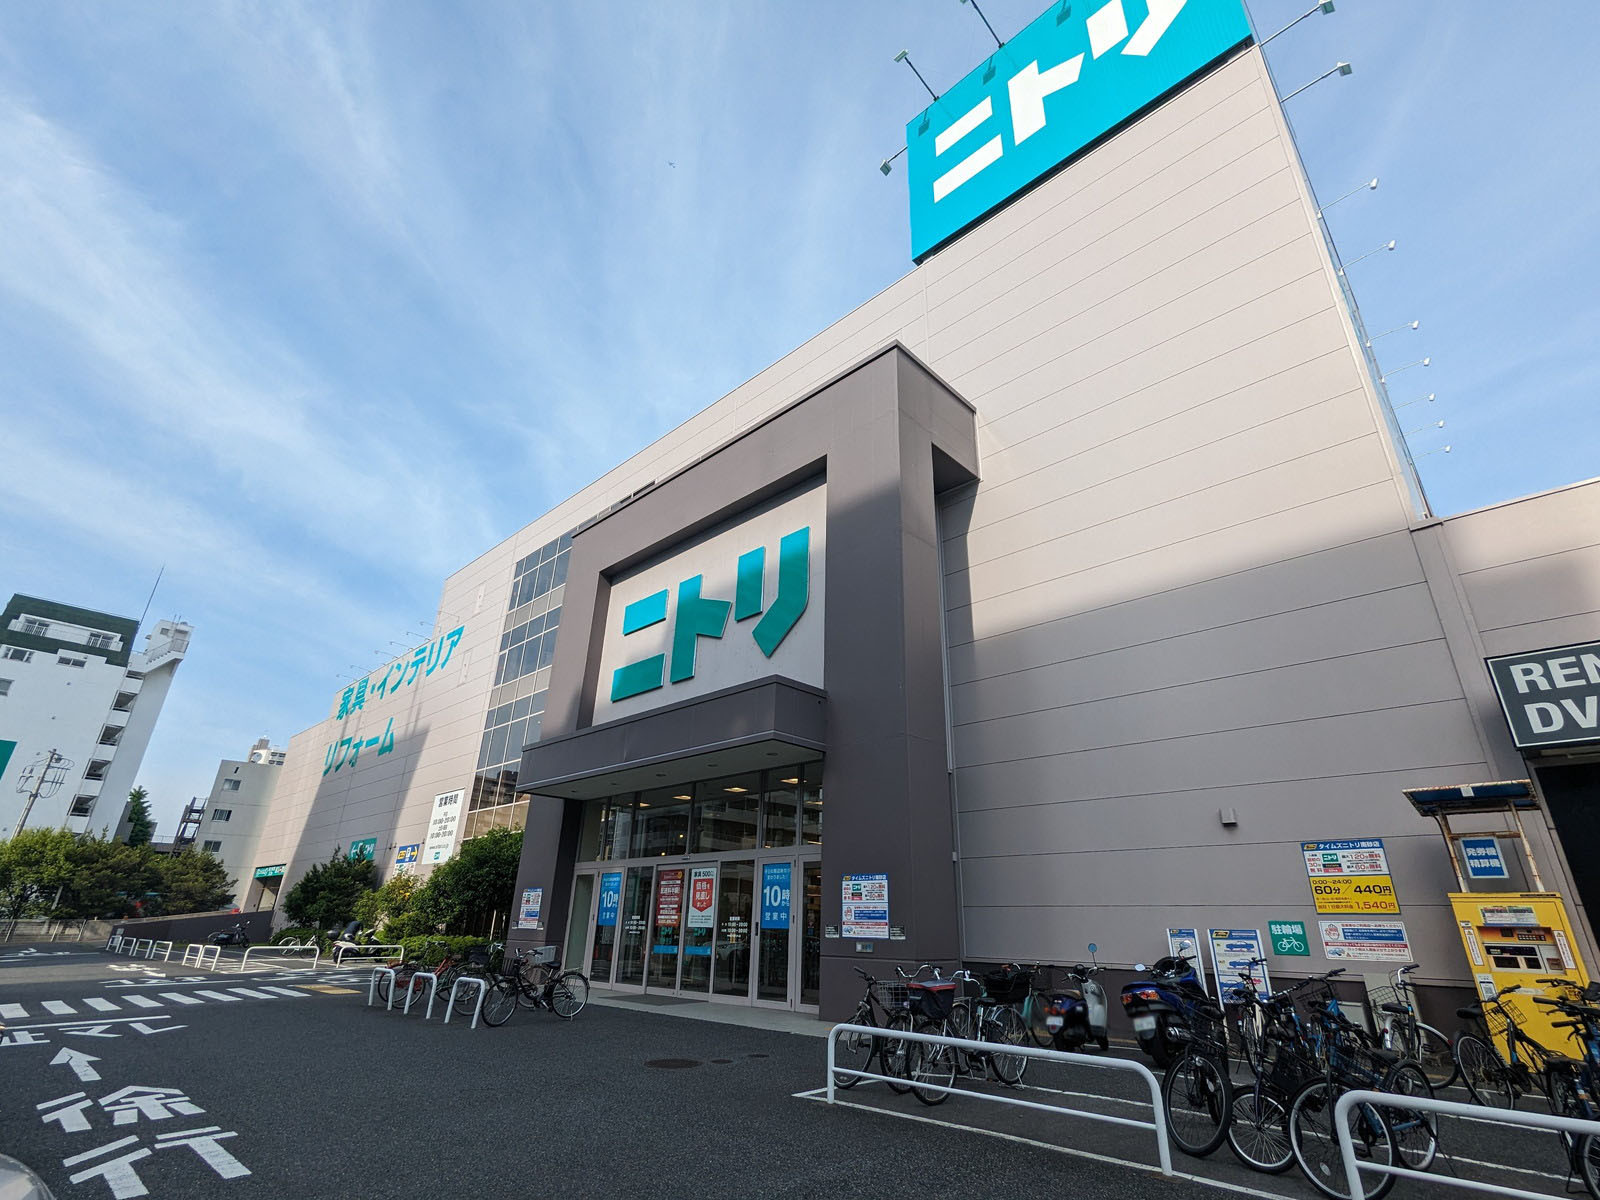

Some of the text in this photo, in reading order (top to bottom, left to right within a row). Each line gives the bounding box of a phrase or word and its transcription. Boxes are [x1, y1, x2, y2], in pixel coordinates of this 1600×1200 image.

[932, 0, 1189, 204] ニトリ
[610, 526, 811, 702] ニトリ
[335, 625, 465, 721] 家具・インテリア
[322, 717, 395, 776] リフォーム
[765, 911, 788, 921] 営業中
[1271, 924, 1303, 935] 駐輪場
